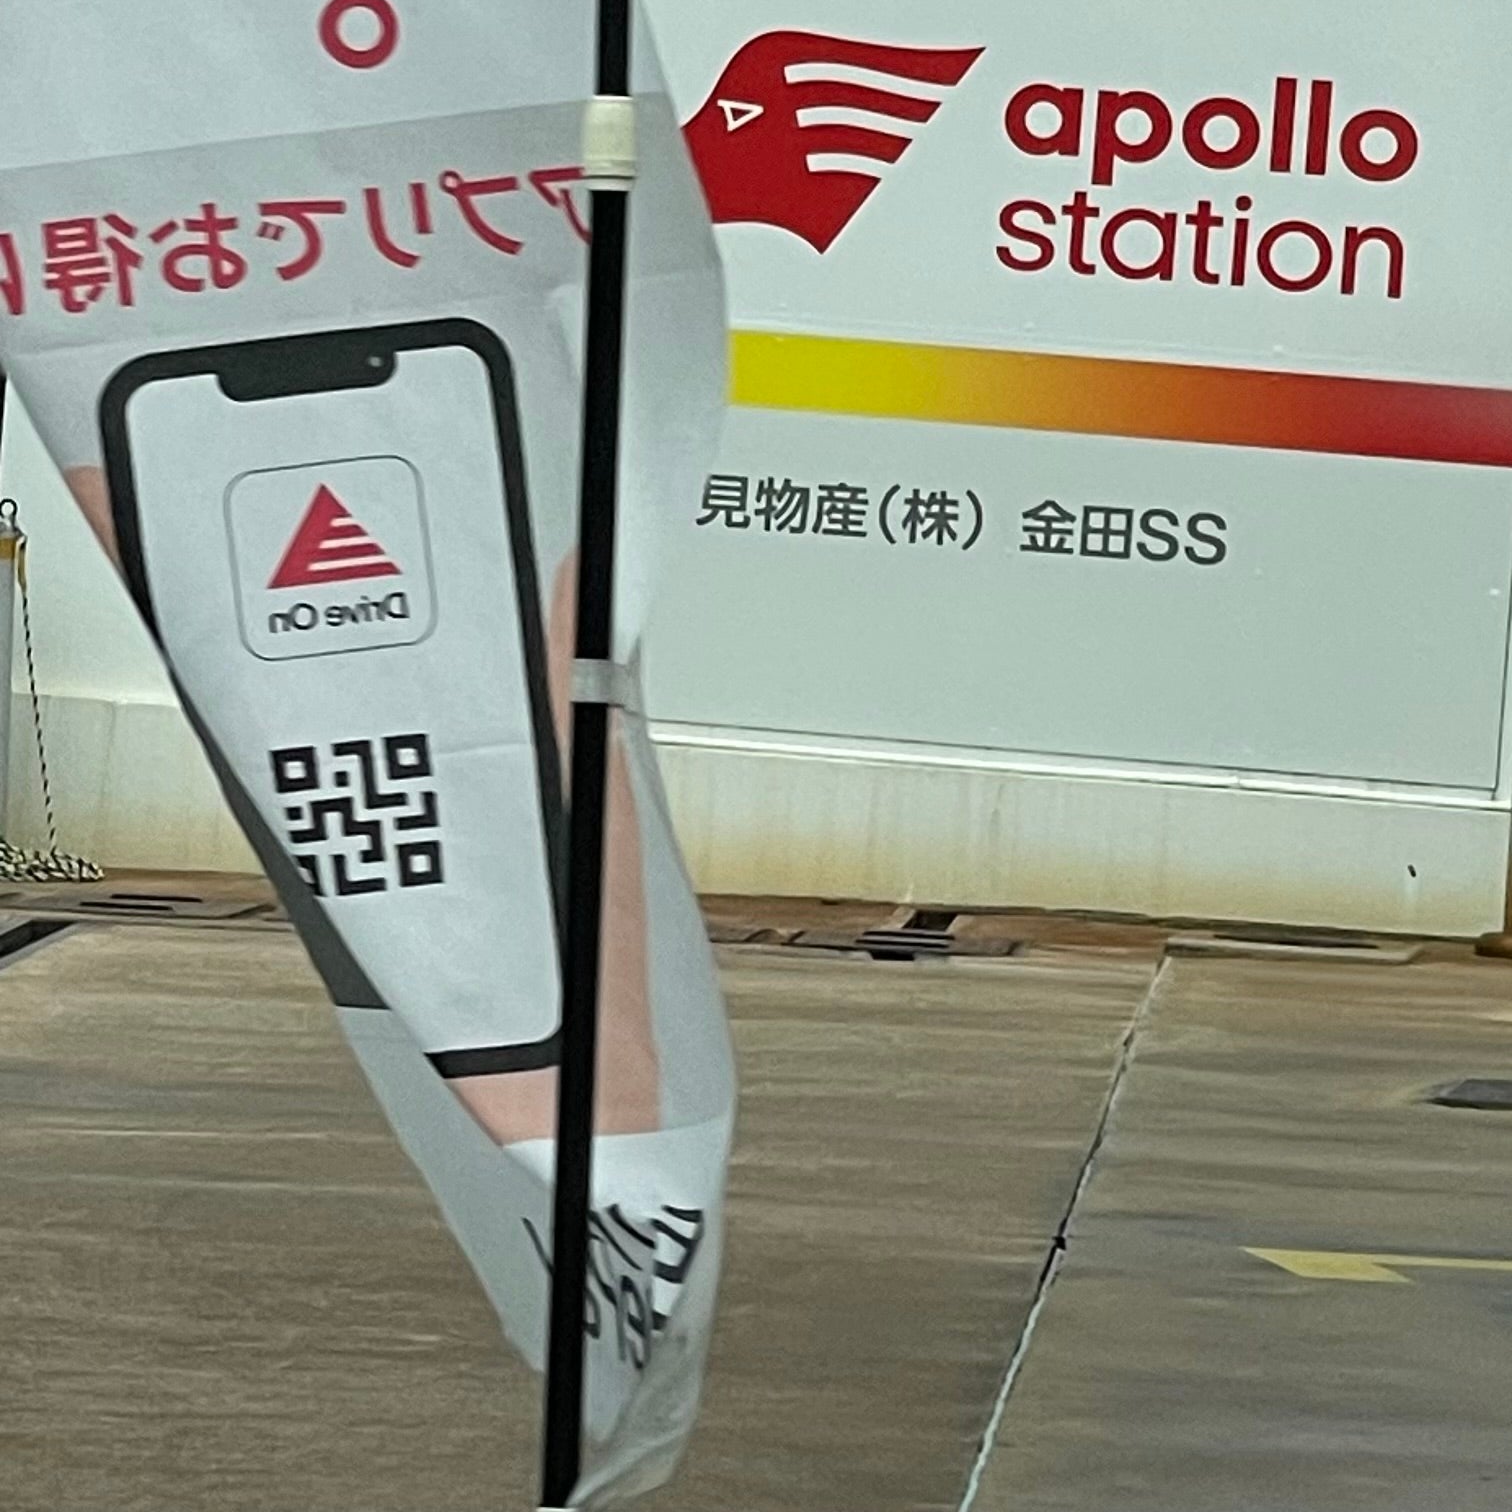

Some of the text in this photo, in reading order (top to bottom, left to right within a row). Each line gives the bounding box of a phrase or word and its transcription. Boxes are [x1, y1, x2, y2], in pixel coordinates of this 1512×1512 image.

[1003, 76, 1419, 186] apollo
[996, 191, 1403, 299] station
[1019, 498, 1228, 566] 金田SS
